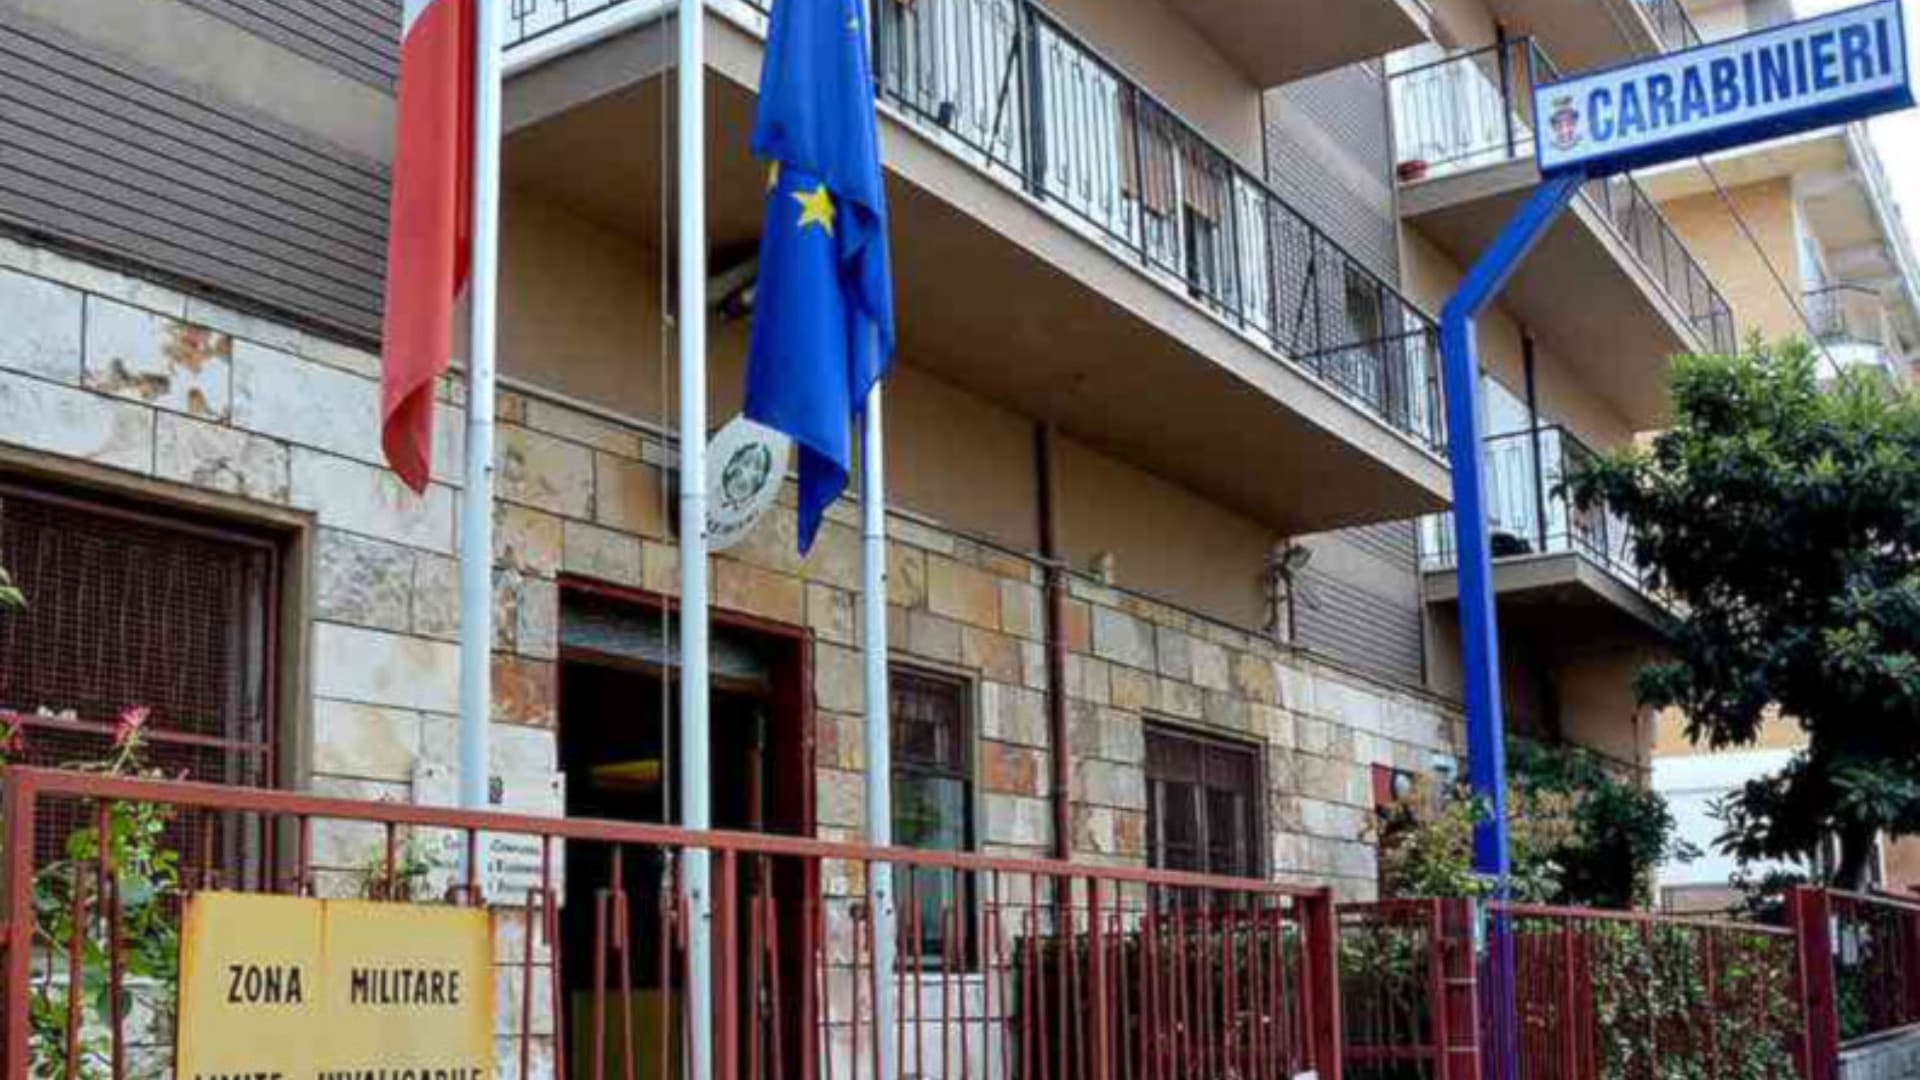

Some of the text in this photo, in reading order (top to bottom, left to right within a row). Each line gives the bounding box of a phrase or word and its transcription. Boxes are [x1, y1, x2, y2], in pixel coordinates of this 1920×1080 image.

[1587, 18, 1892, 142] CARABINIERI
[228, 964, 460, 1004] ZONA MILITARE
